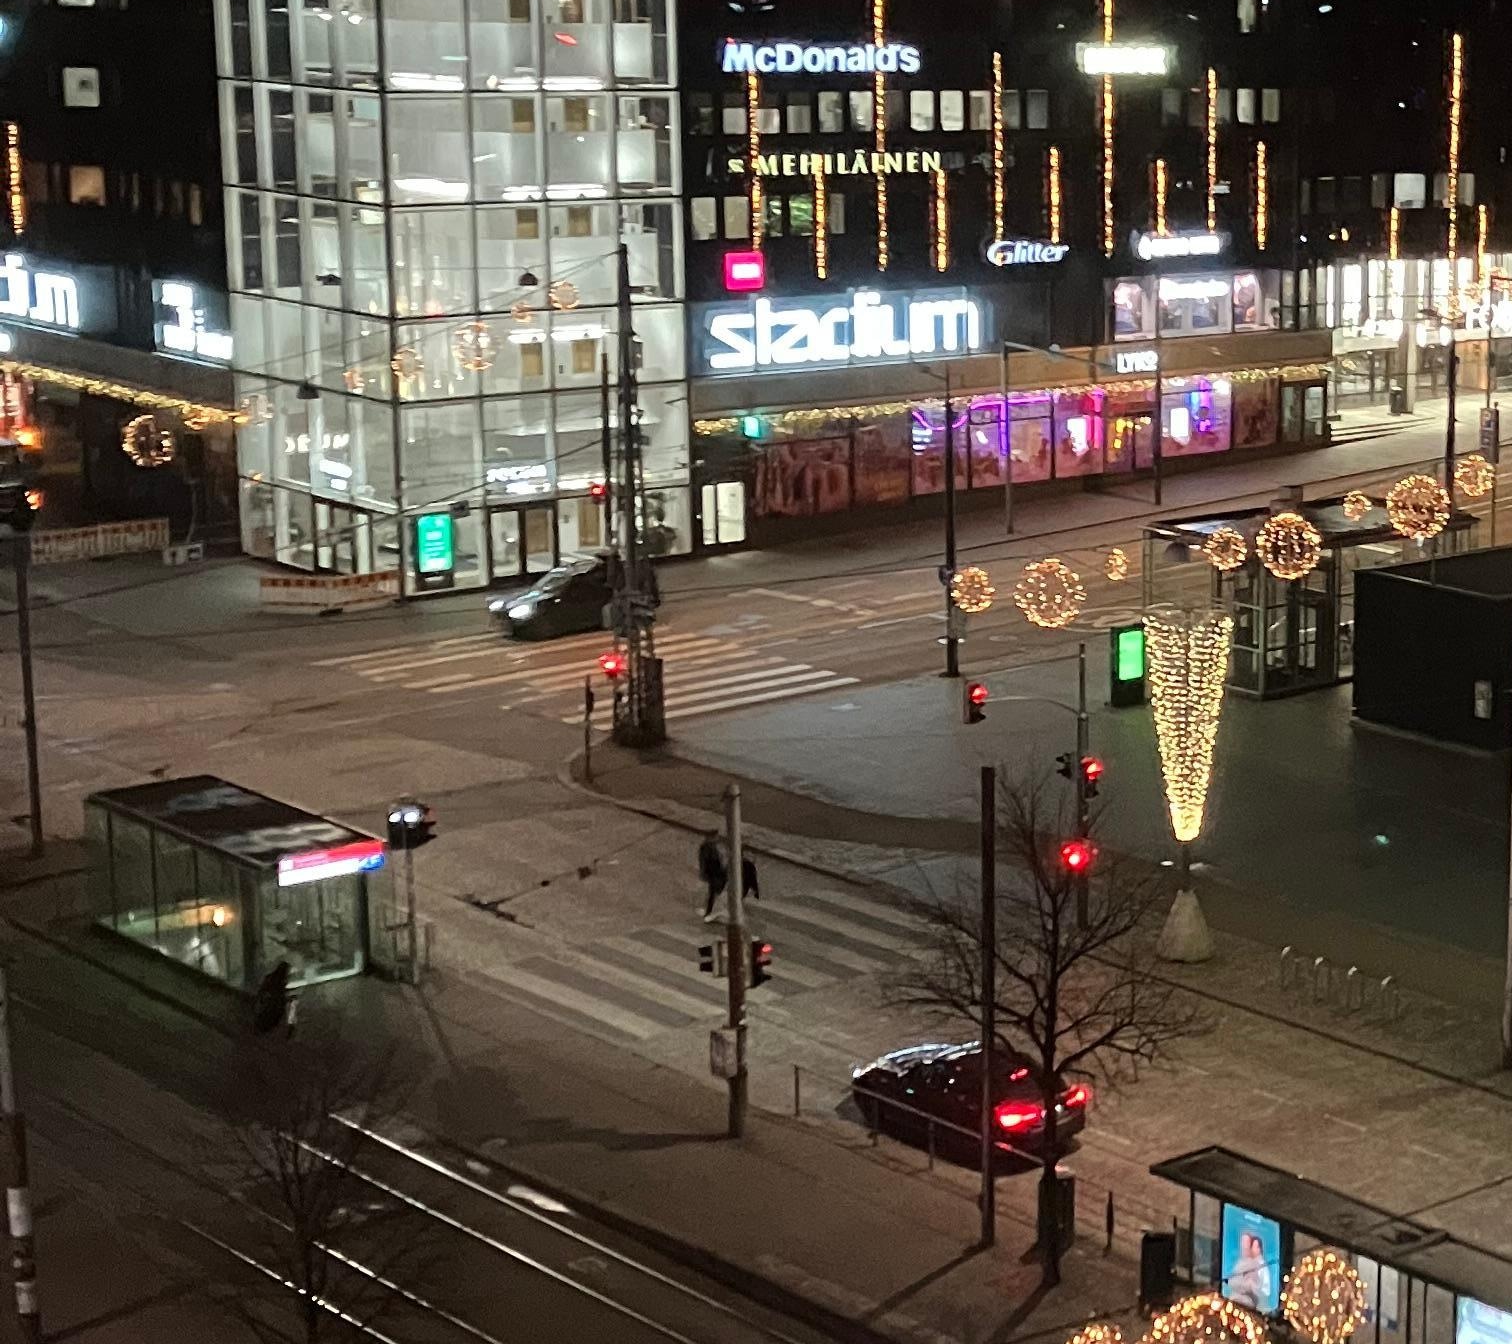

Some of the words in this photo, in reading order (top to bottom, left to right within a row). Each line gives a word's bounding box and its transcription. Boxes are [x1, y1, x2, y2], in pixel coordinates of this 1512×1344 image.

[722, 42, 921, 73] McDonald's
[755, 149, 940, 176] MEHILÄINEN
[986, 240, 1069, 267] Glitter
[710, 292, 979, 368] stadium
